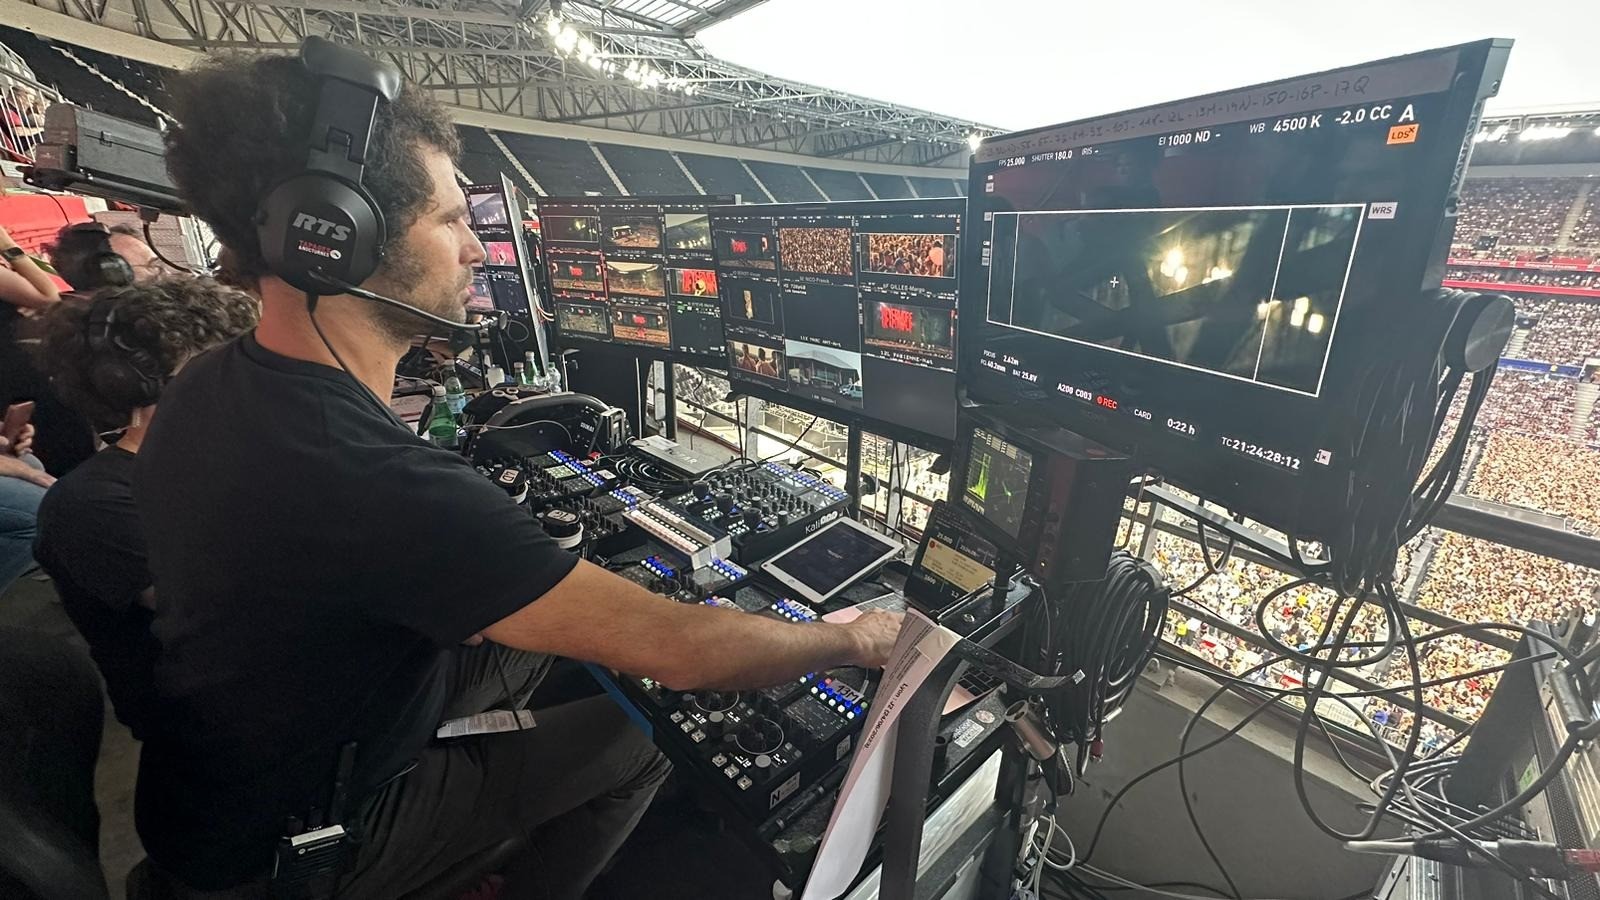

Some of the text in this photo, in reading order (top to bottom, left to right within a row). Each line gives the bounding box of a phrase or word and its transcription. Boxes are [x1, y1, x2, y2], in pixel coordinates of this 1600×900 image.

[1335, 104, 1393, 125] -2.0 CC
[1398, 104, 1415, 122] A
[1249, 114, 1323, 134] WB 4500 K
[1168, 133, 1192, 146] 1000
[1195, 130, 1211, 143] ND
[1031, 150, 1073, 163] SHUTTER 180.0
[1371, 205, 1393, 215] WRS
[292, 212, 352, 241] RTS
[1075, 388, 1092, 401] C003
[1102, 397, 1118, 409] REC
[1133, 408, 1196, 436] CARD 0:22 h
[1232, 439, 1301, 470] 21:24:28:12
[837, 684, 859, 702] 13M
[896, 683, 909, 698] Lyon
